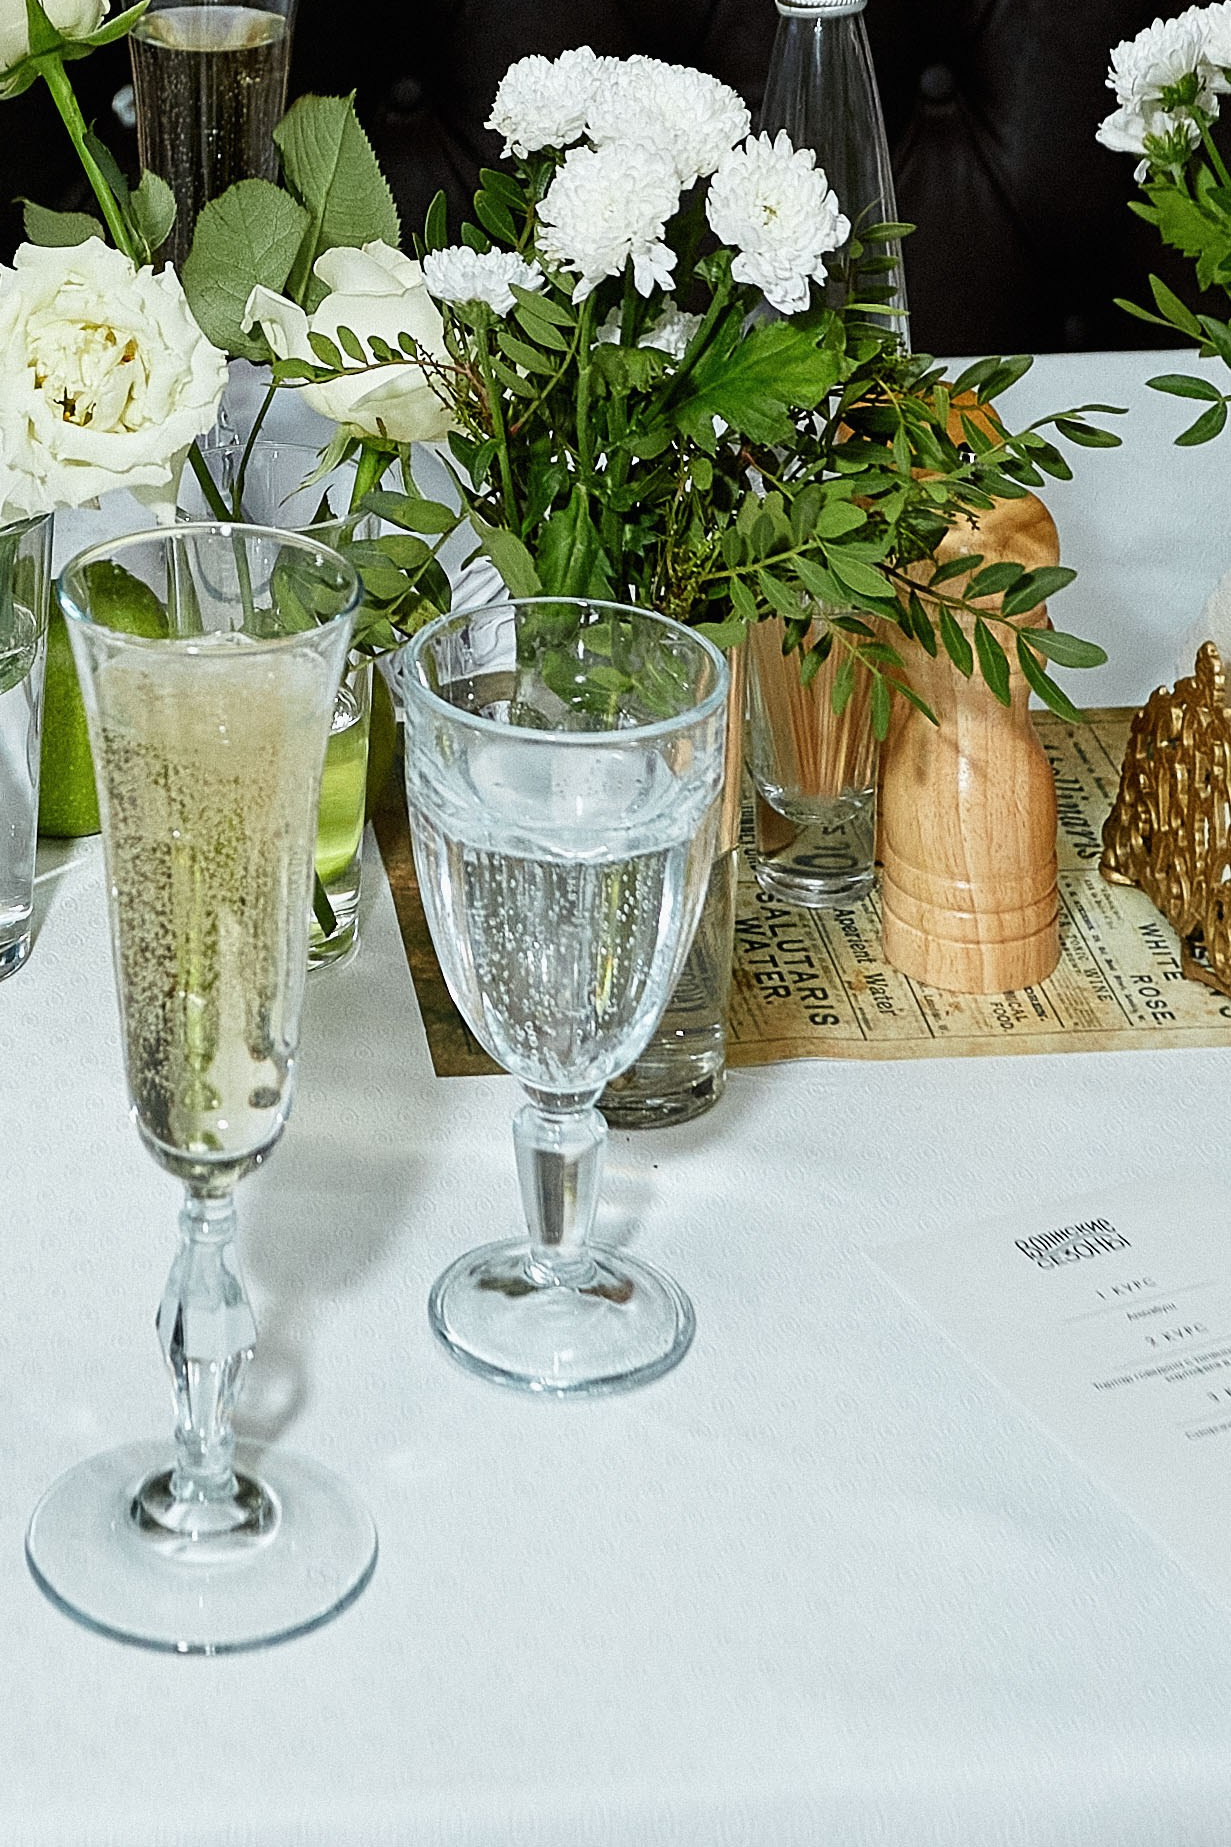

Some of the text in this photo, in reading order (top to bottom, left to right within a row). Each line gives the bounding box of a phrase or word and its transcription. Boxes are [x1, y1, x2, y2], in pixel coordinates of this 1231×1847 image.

[735, 917, 791, 1004] WATER.
[756, 891, 840, 1027] SALUTARIS
[833, 908, 898, 1016] Aperient Water
[1084, 968, 1114, 1003] WINE
[1138, 922, 1186, 981] WHITE
[1131, 974, 1176, 1025] ROSE.
